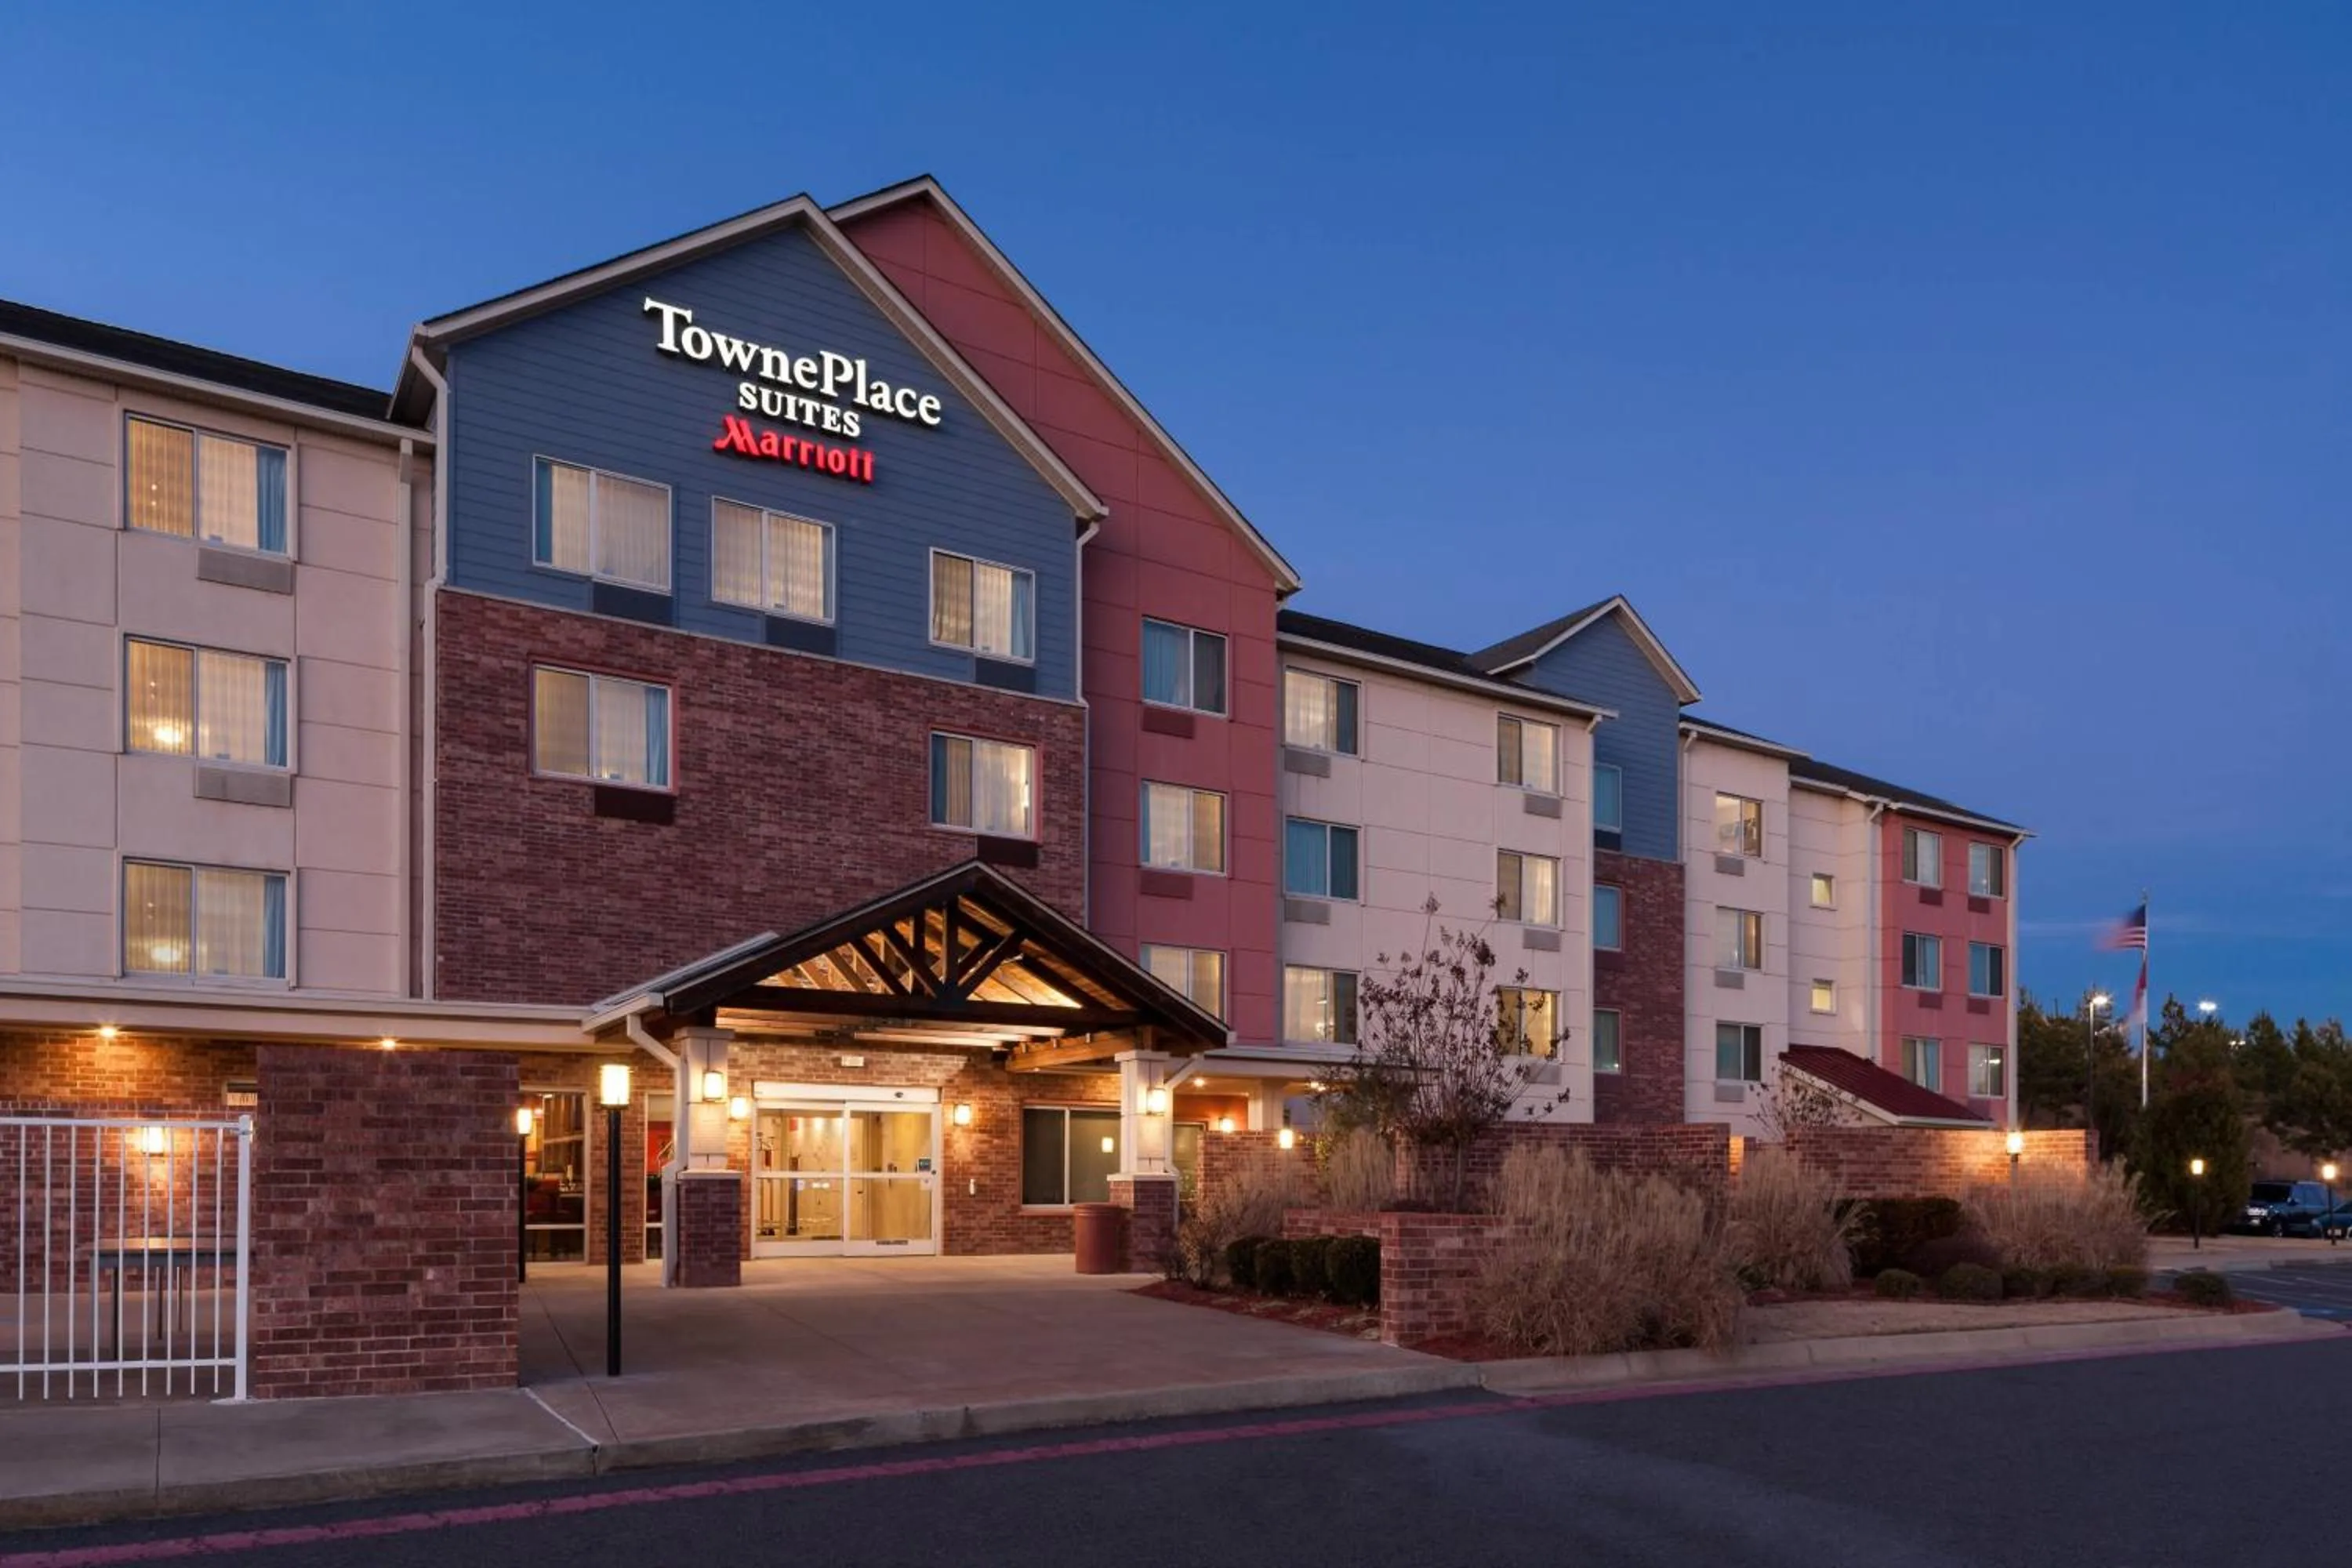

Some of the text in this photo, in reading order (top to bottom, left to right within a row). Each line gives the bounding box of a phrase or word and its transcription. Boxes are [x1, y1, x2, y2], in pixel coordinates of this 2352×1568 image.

[643, 296, 942, 426] TownePlace
[739, 382, 861, 438] SUITES
[713, 414, 874, 482] Marriott
